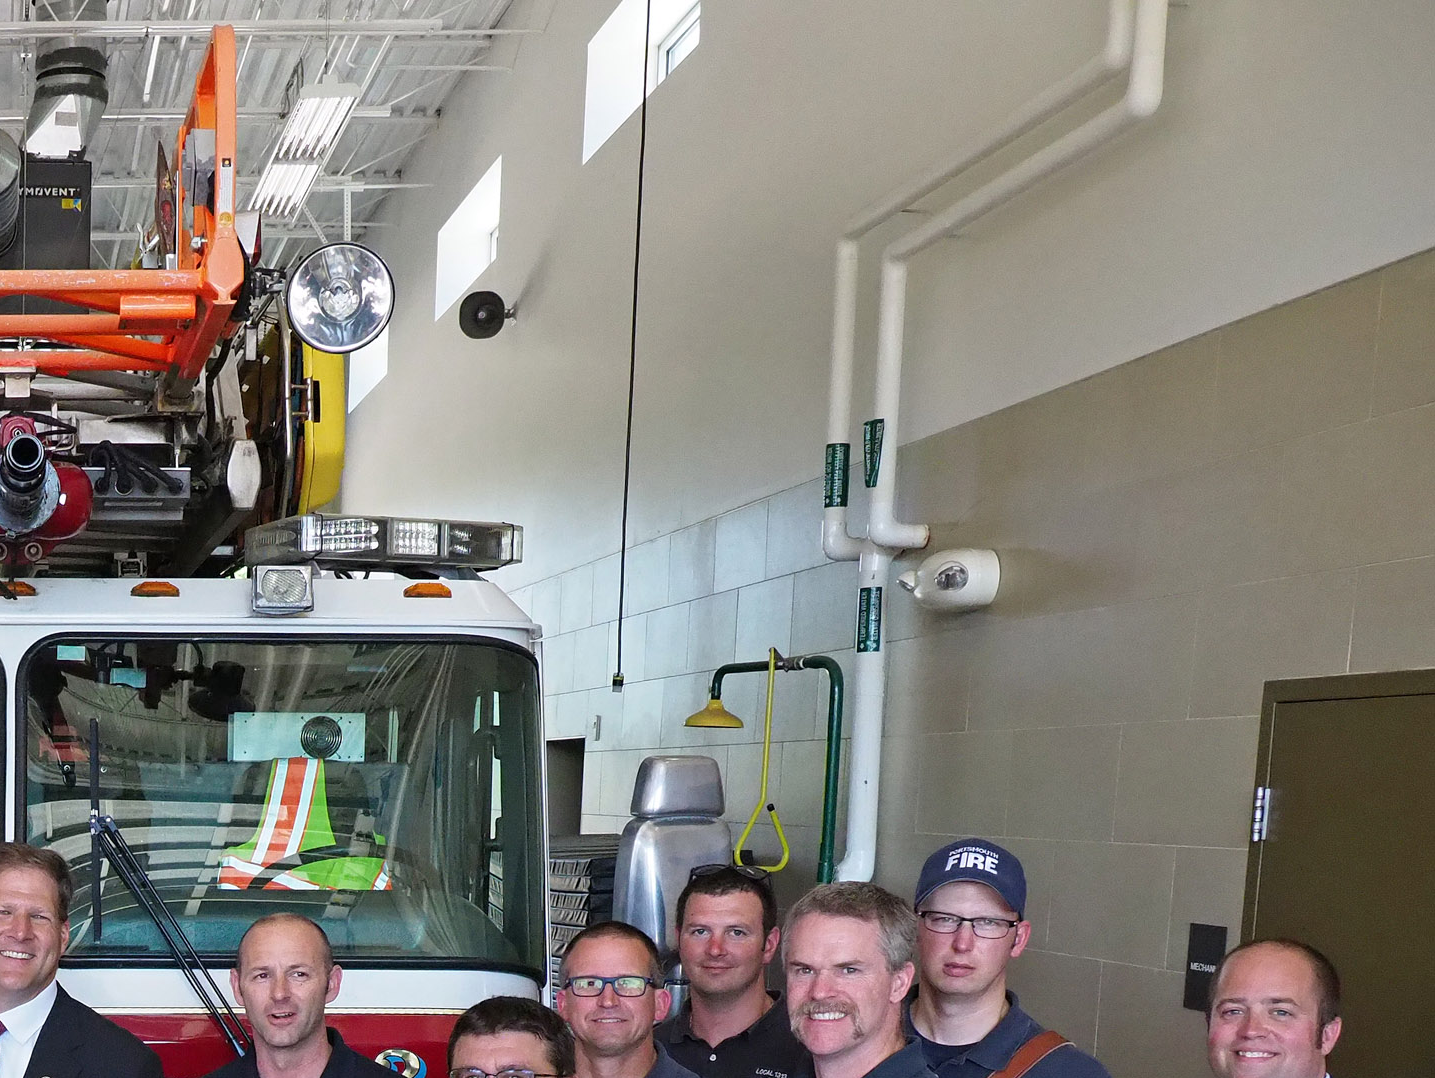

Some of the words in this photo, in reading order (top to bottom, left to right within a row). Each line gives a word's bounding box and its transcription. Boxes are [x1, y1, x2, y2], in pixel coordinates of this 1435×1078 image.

[19, 187, 76, 196] YMOVENT
[945, 852, 999, 875] FIRE
[1190, 962, 1217, 974] MECHAN
